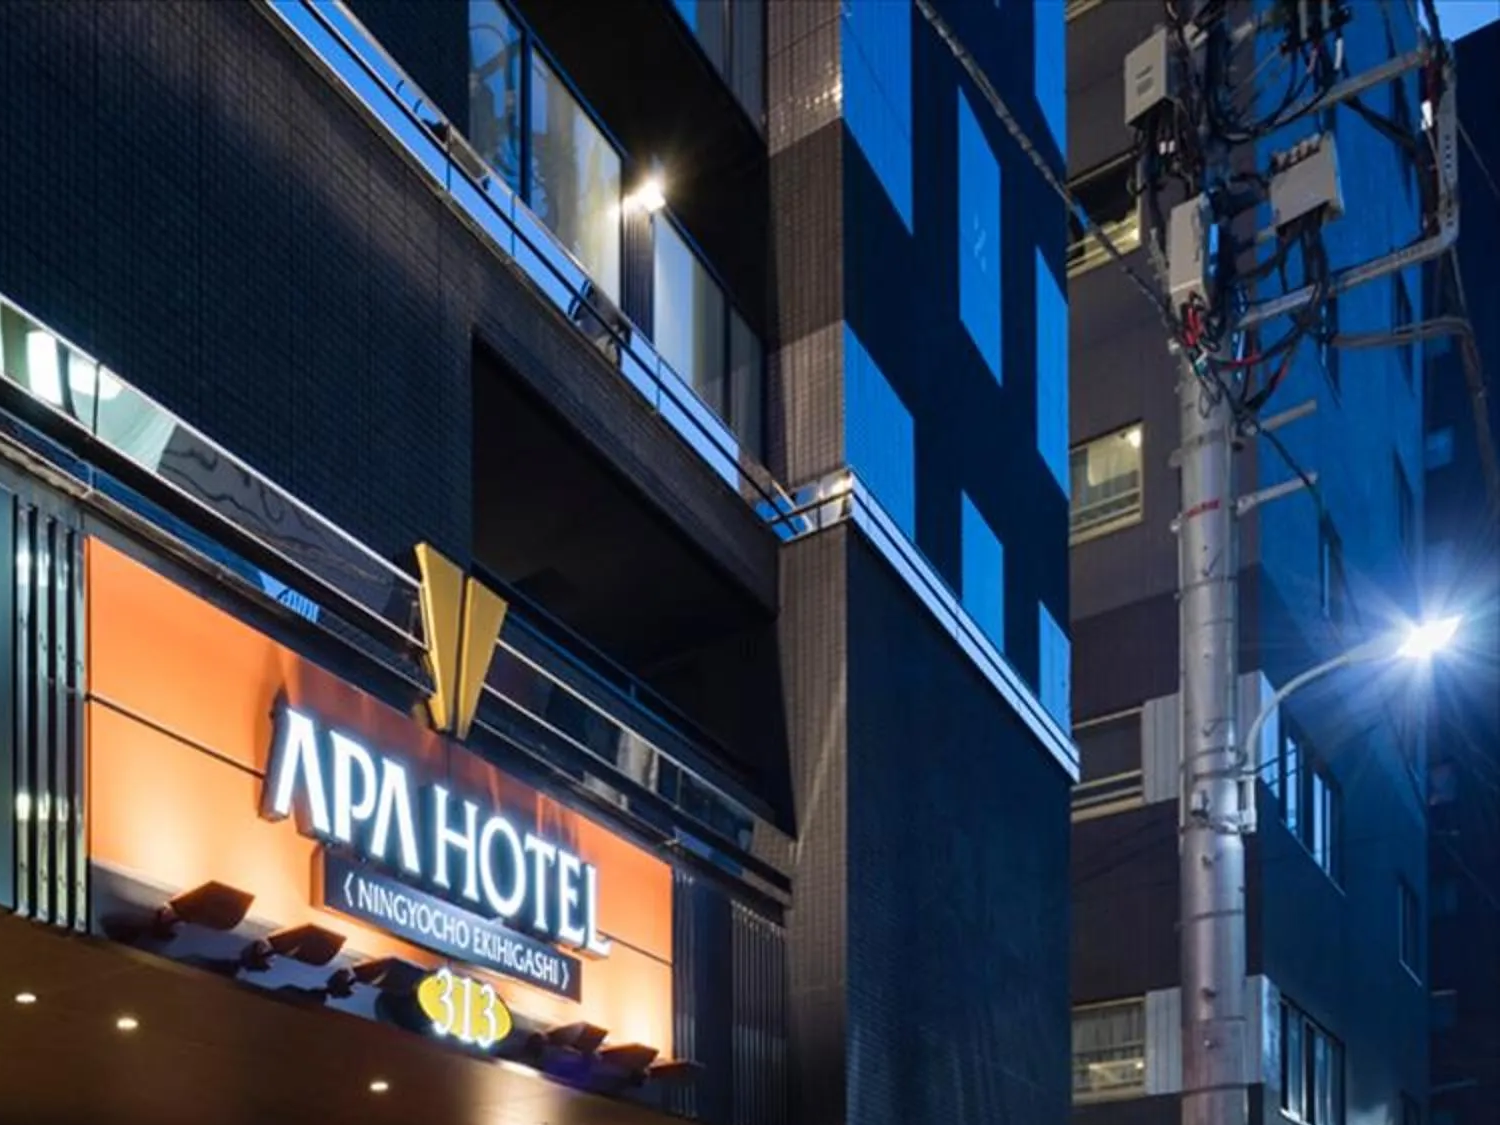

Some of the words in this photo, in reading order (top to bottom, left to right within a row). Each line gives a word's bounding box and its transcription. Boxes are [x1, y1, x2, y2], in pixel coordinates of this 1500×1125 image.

[274, 708, 421, 875] APA
[433, 784, 611, 954] HOTEL
[433, 966, 498, 1048] 313
